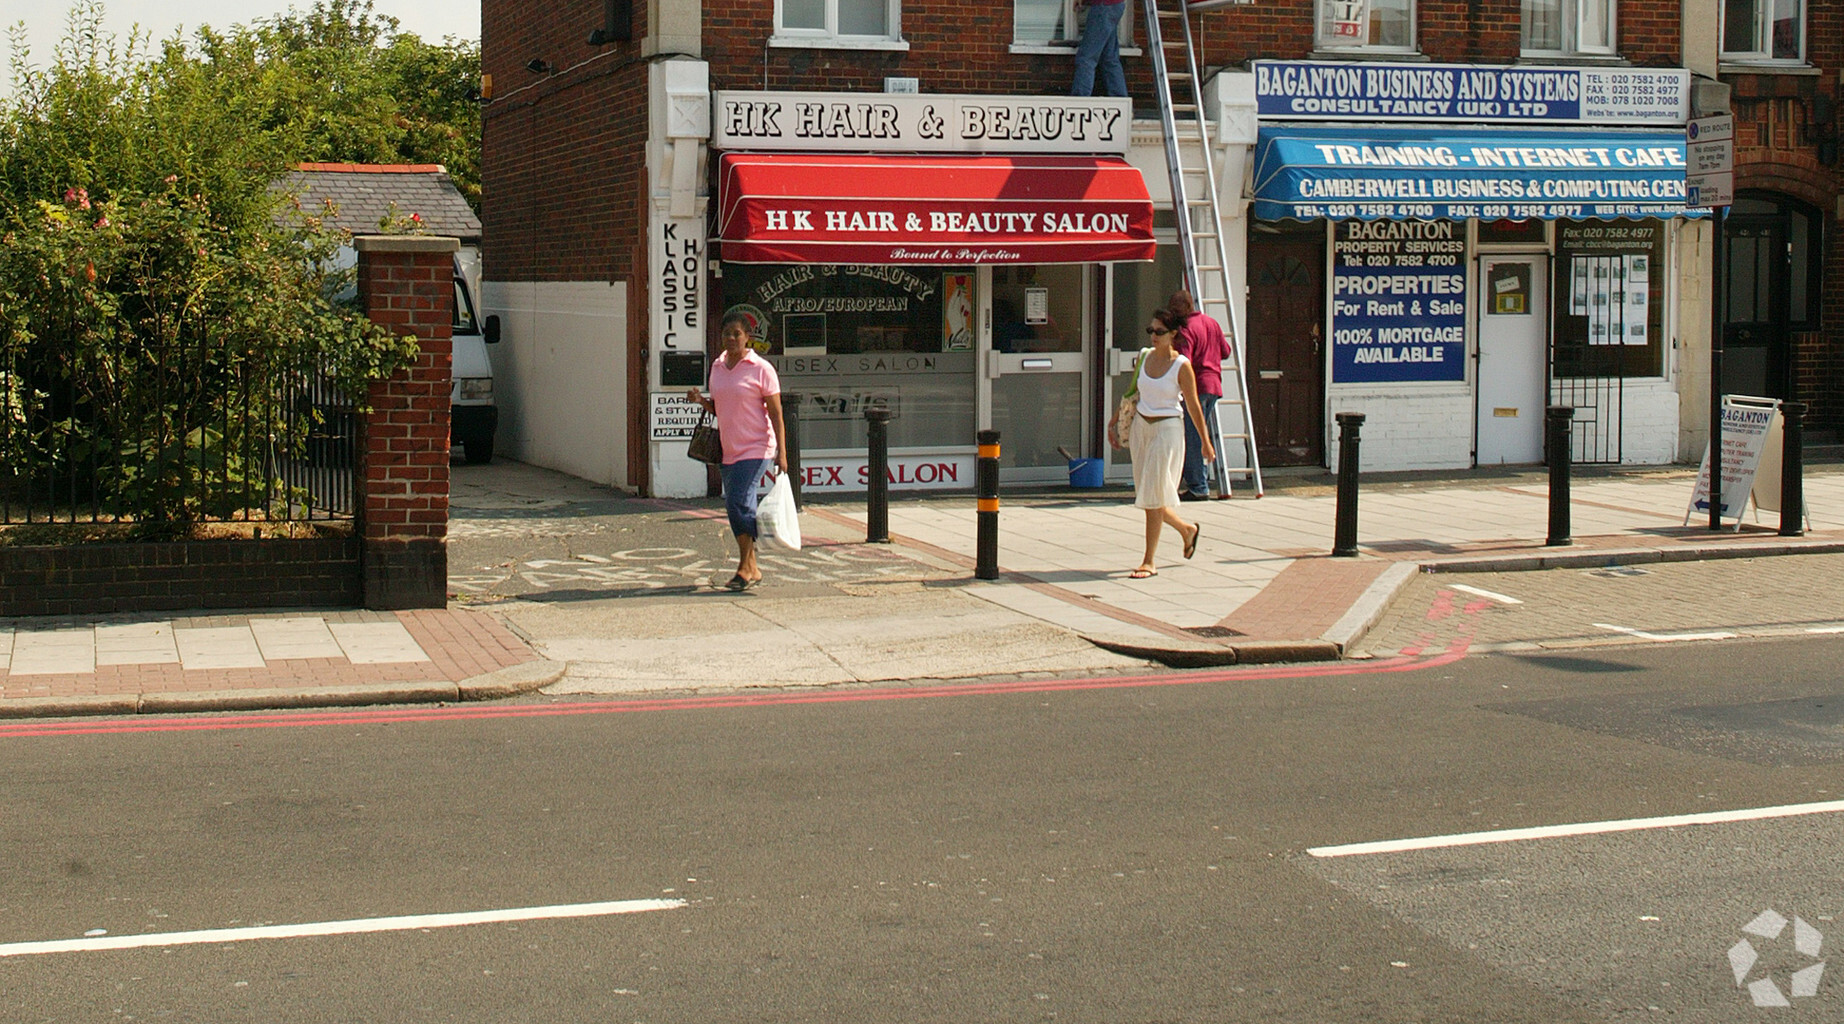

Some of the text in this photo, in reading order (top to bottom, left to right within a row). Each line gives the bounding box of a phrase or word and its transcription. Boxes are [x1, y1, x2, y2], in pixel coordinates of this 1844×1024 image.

[1257, 67, 1579, 101] BAGANTON BUSINESS AND SYSTEMS
[1611, 75, 1628, 84] 020
[1631, 76, 1654, 84] 7582
[1656, 76, 1679, 84] 4700
[1612, 86, 1629, 94] 020
[1632, 86, 1654, 94] 7582
[1656, 86, 1679, 95] 4977
[1291, 98, 1548, 116] CONSULTANCY (UK) LTD
[1586, 96, 1679, 105] MOB: 078 1020 7008
[725, 102, 1121, 141] HK HAIR & BEAUTY
[1315, 144, 1458, 166] TRAINING
[1470, 147, 1611, 166] INTERNET
[1615, 147, 1686, 166] CAFE
[1299, 179, 1687, 198] CAMBERWELL BUSINESS & COMPUTING CEN
[1294, 205, 1325, 217] TEL:
[1328, 205, 1355, 217] 020
[1359, 205, 1394, 216] 7582
[1398, 205, 1434, 216] 4700
[1448, 205, 1479, 216] FAX:
[1483, 205, 1509, 216] 020
[1513, 205, 1545, 216] 7582
[1549, 205, 1581, 216] 4977
[1595, 205, 1614, 215] WEB
[1616, 205, 1638, 214] SITE:
[825, 211, 898, 232] HAIR
[904, 212, 923, 232] &
[929, 212, 1036, 233] BEAUTY
[1043, 212, 1129, 233] SALON
[1348, 222, 1452, 239] BAGANTON
[1563, 228, 1654, 238] Fax: 020 7582 4977
[1335, 241, 1463, 253] PROPERTY SERVICES
[889, 248, 1020, 263] Bound to Perfection
[1343, 255, 1456, 266] Tel: 020 7582 4700
[663, 223, 678, 349] KLASSIC
[683, 239, 698, 328] HOUSE
[757, 264, 815, 303] HAIR
[845, 265, 934, 302] BEAUTY
[1334, 275, 1464, 295] PROPERTIES
[773, 296, 908, 312] AFRO/EUROPEAN
[1334, 299, 1464, 316] For Rent & Sale
[1334, 327, 1463, 345] 100% MORTGAGE
[1353, 347, 1444, 363] AVAILABLE
[777, 357, 936, 372] ISEX SALON
[658, 417, 711, 425] REQUIRD
[1721, 409, 1770, 424] BAGANTON
[656, 428, 680, 436] APPLY
